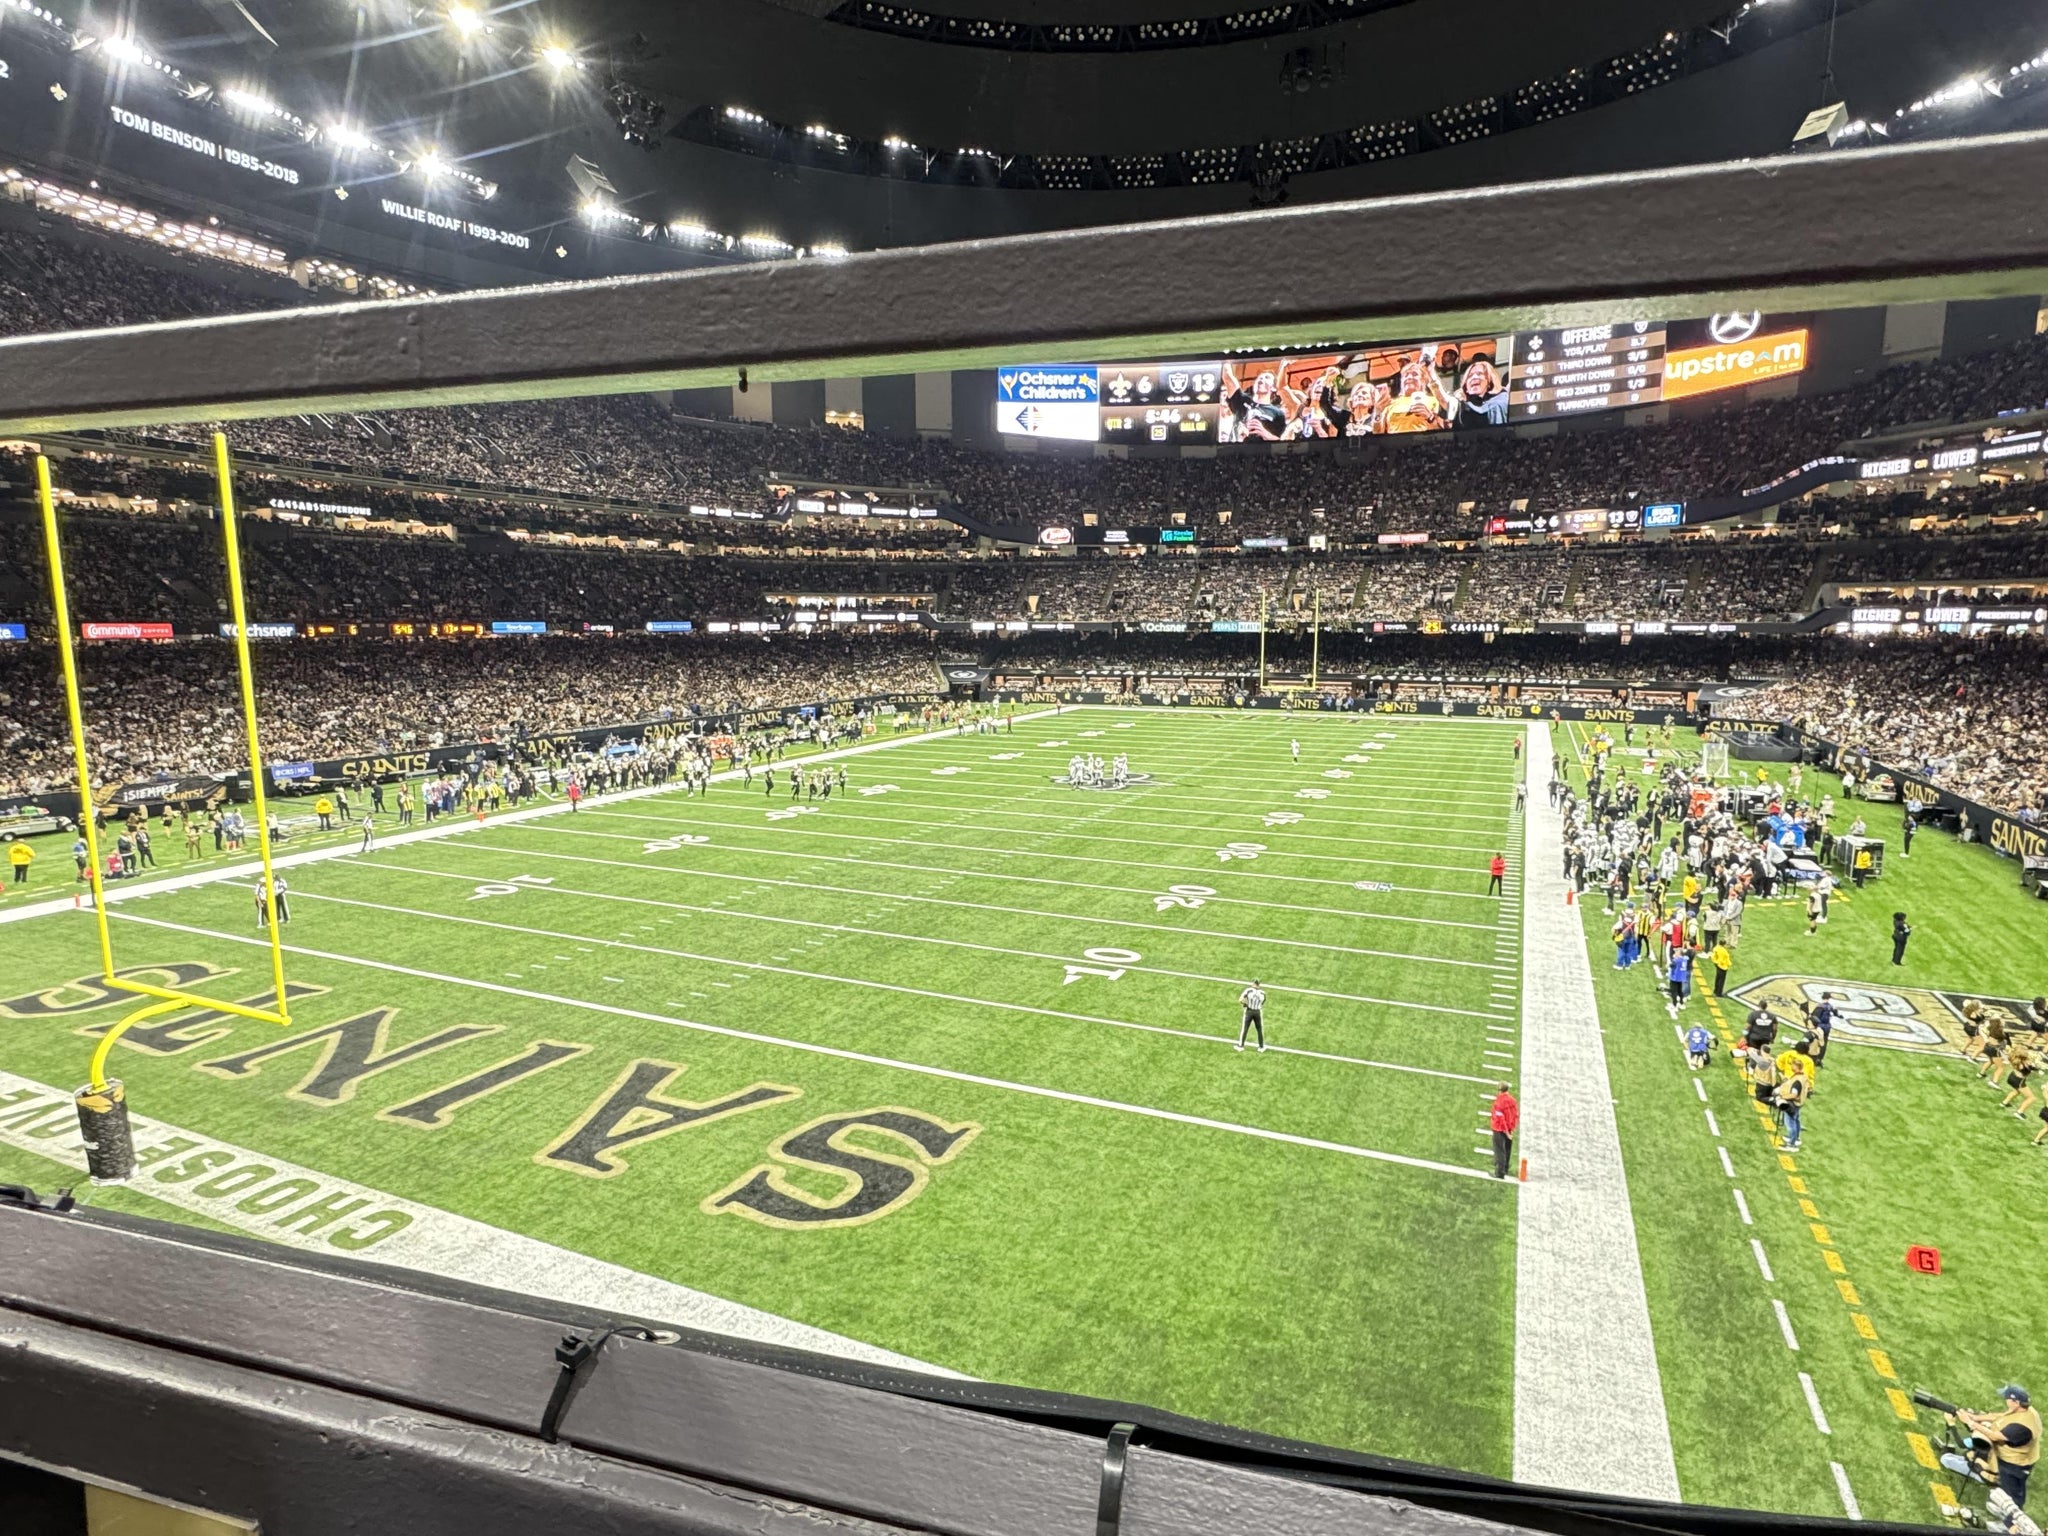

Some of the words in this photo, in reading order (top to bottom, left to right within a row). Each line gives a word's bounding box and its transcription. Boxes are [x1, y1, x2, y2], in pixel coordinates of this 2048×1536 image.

[110, 105, 149, 134] TOM
[152, 121, 216, 157] BENSON
[224, 148, 299, 185] 1985-2018
[382, 198, 426, 223] WILLIE
[427, 212, 461, 231] ROAF
[468, 222, 529, 249] 1993-2001
[1562, 325, 1612, 345] OFFENSE
[1585, 355, 1612, 367] DOWN
[1019, 371, 1077, 385] Ochsner
[1138, 375, 1152, 394] 6
[1192, 373, 1215, 392] 13
[1553, 373, 1587, 385] FOURTH
[1588, 369, 1615, 381] DOWN
[1019, 385, 1087, 399] Children's
[1556, 397, 1609, 411] TURNOVERS
[1123, 417, 1132, 430] 2
[1146, 409, 1180, 424] 5:46
[1861, 458, 1911, 479] HIGHER
[1914, 459, 1929, 470] OR
[1932, 448, 1978, 470] LOWER
[1982, 444, 2026, 459] PRESENTED
[2027, 442, 2041, 453] BY
[269, 498, 320, 511] CAESARS
[320, 503, 372, 516] SUPERDOME
[1505, 520, 1532, 530] TOYOTA
[1549, 514, 1560, 528] 6
[1609, 511, 1624, 524] 13
[1652, 507, 1674, 517] BUD
[1647, 513, 1678, 525] LIGHT
[1852, 609, 1901, 623] HIGHER
[1905, 611, 1920, 621] OR
[1924, 608, 1972, 623] LOWER
[87, 624, 142, 638] Community
[1146, 621, 1187, 633] Ochsner
[1384, 623, 1408, 631] TOYOTA
[1451, 623, 1500, 633] CAESARS
[1021, 693, 1057, 703] SAINTS
[1585, 708, 1635, 722] SAINTS
[1709, 720, 1779, 735] SAINTS
[342, 753, 427, 776] SAINTS
[1904, 780, 1940, 805] SAINTS
[642, 834, 711, 852] 20
[1990, 818, 2047, 858] SAINTS
[1216, 842, 1268, 860] 30
[474, 874, 555, 896] 10
[1153, 884, 1217, 910] 20
[1063, 947, 1142, 982] 10
[0, 961, 983, 1229] SAINTS
[134, 1136, 414, 1252] CHOOSE
[1918, 1250, 1935, 1271] G
